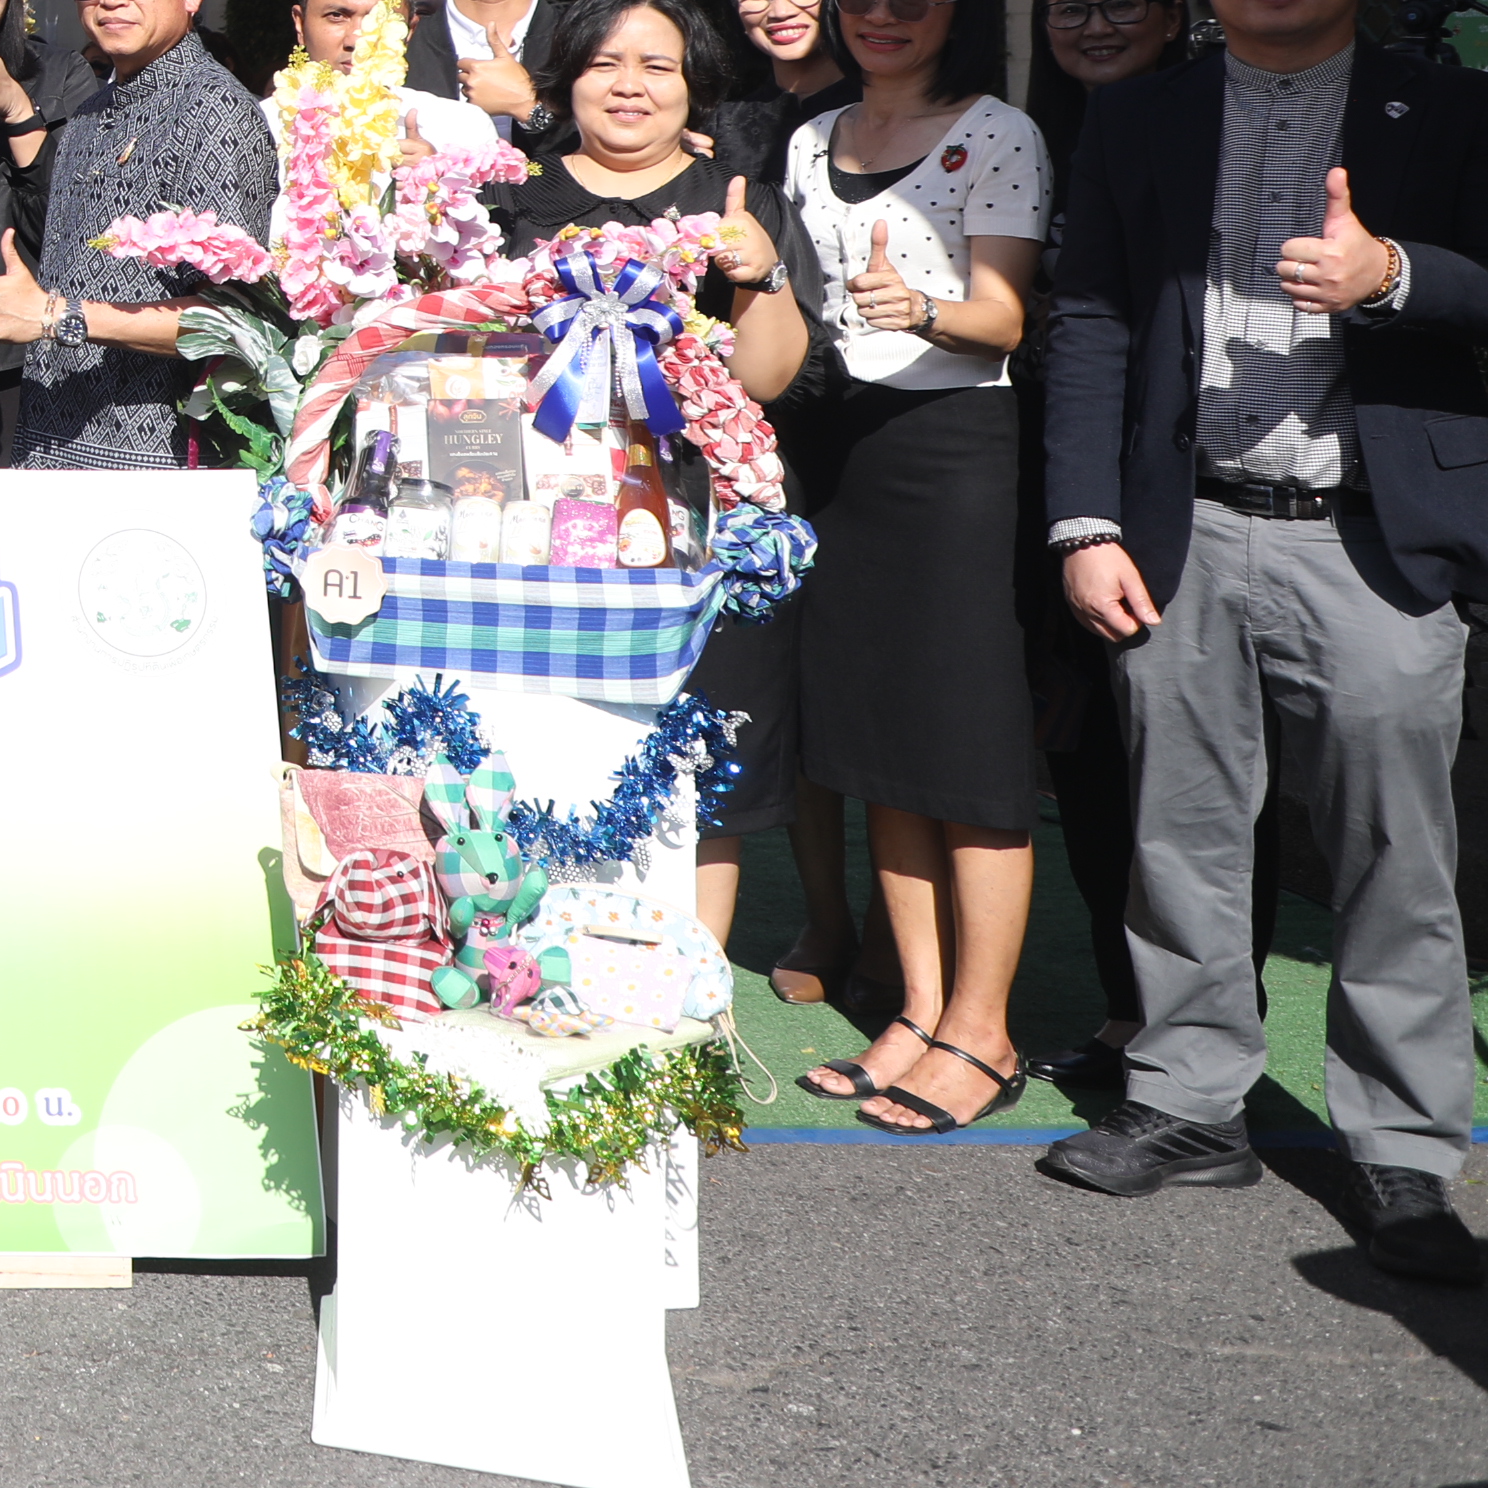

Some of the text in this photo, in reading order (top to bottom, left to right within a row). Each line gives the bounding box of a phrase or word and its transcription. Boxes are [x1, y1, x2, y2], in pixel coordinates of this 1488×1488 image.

[444, 433, 504, 445] HUNGLEY
[349, 513, 384, 532] CHANG
[323, 568, 363, 600] A1
[43, 1096, 75, 1118] น.
